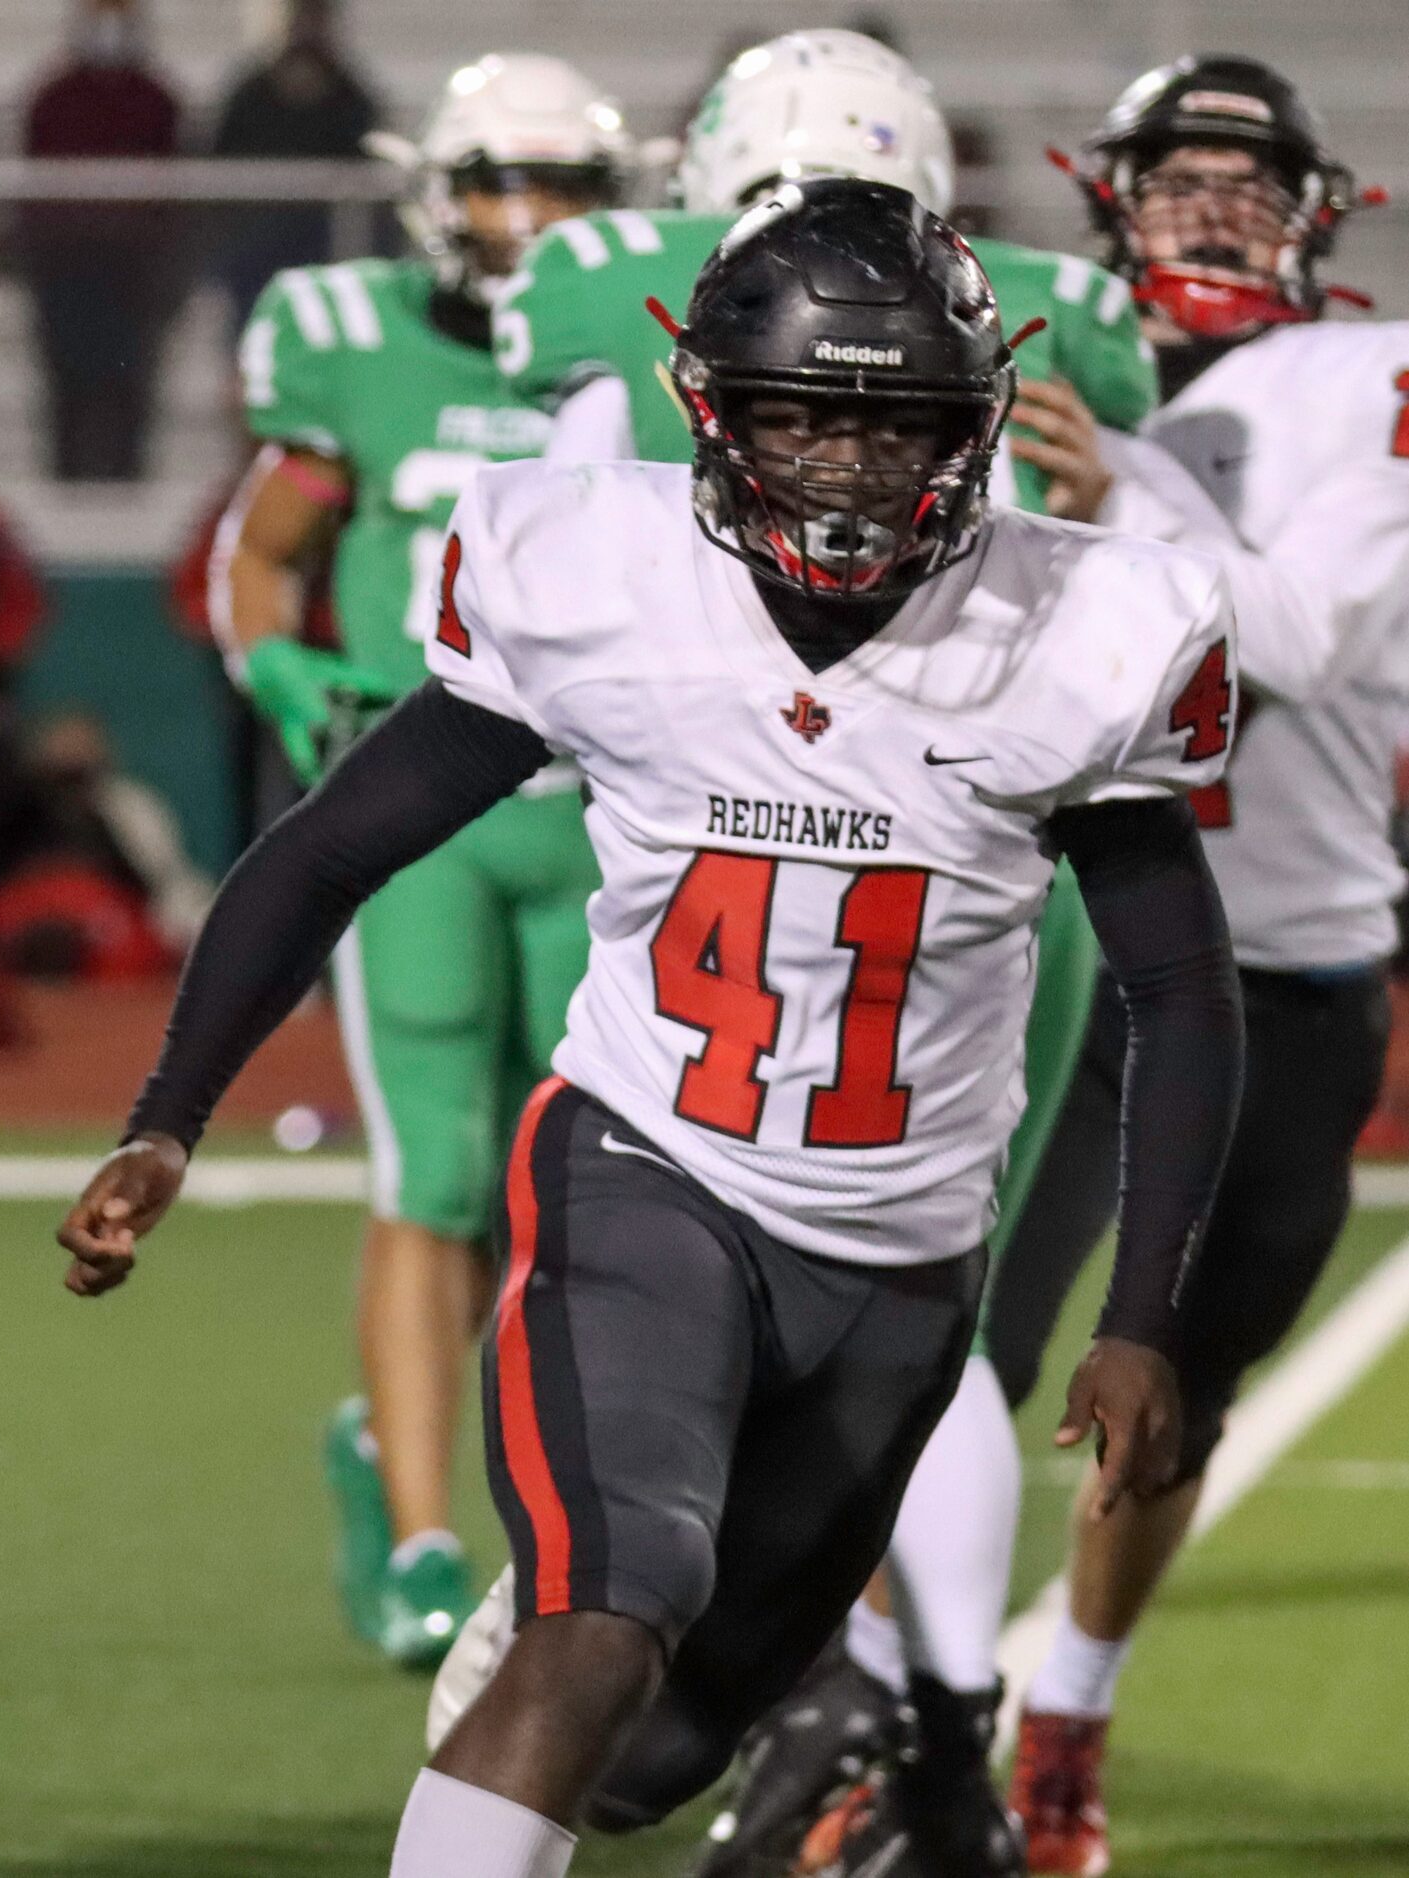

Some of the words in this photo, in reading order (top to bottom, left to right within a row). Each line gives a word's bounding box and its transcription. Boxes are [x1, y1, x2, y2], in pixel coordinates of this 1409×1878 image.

[814, 340, 903, 366] Riddell
[1168, 634, 1232, 764] 4
[707, 794, 892, 850] REDHAWKS
[648, 846, 930, 1149] 41
